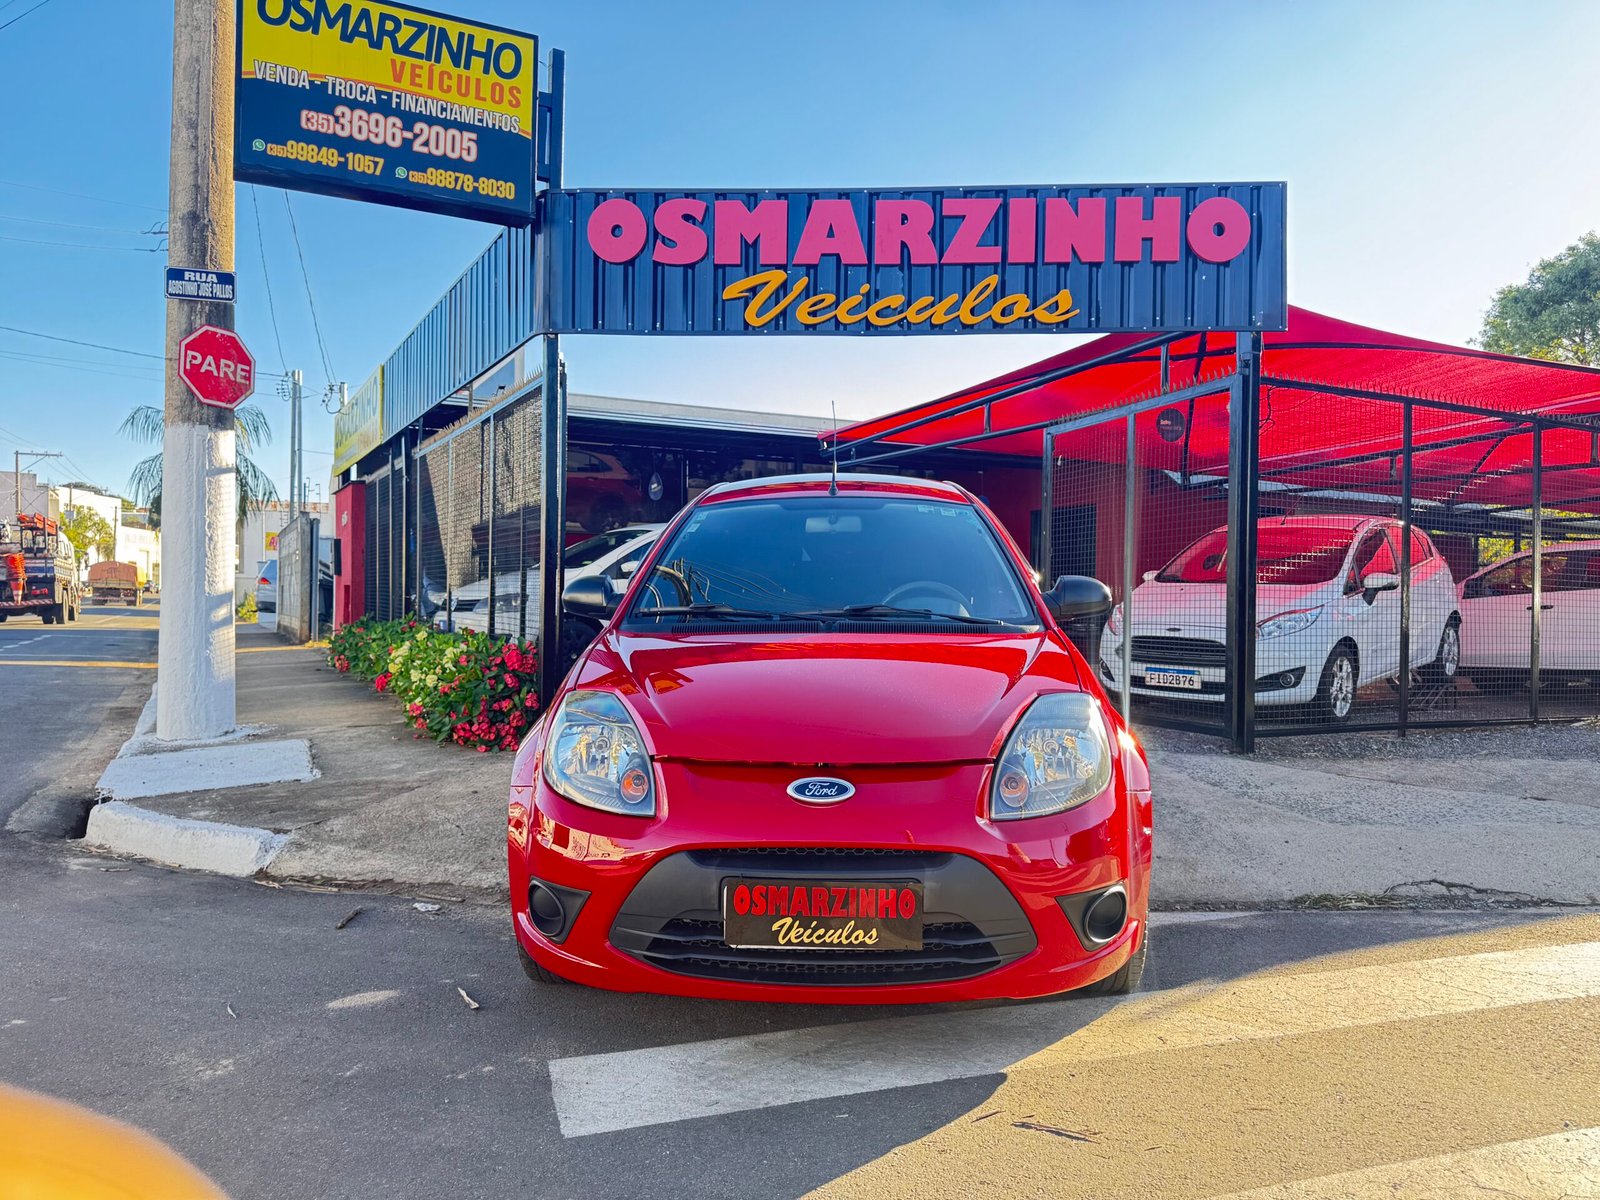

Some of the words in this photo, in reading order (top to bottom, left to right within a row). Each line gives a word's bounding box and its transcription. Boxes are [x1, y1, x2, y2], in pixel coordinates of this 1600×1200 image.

[256, 0, 523, 79] OSMARZINHO
[253, 59, 310, 90] VENDA
[325, 76, 377, 104] TROCA
[391, 91, 520, 134] FINANCIAMENTOS
[390, 58, 522, 108] VEÍCULOS
[587, 196, 1252, 266] OSMARZINHO
[184, 271, 218, 283] RUA
[185, 350, 250, 384] PARE
[1149, 673, 1195, 686] FID2B76
[805, 782, 838, 796] Ford
[733, 884, 916, 919] OSMARZINHO
